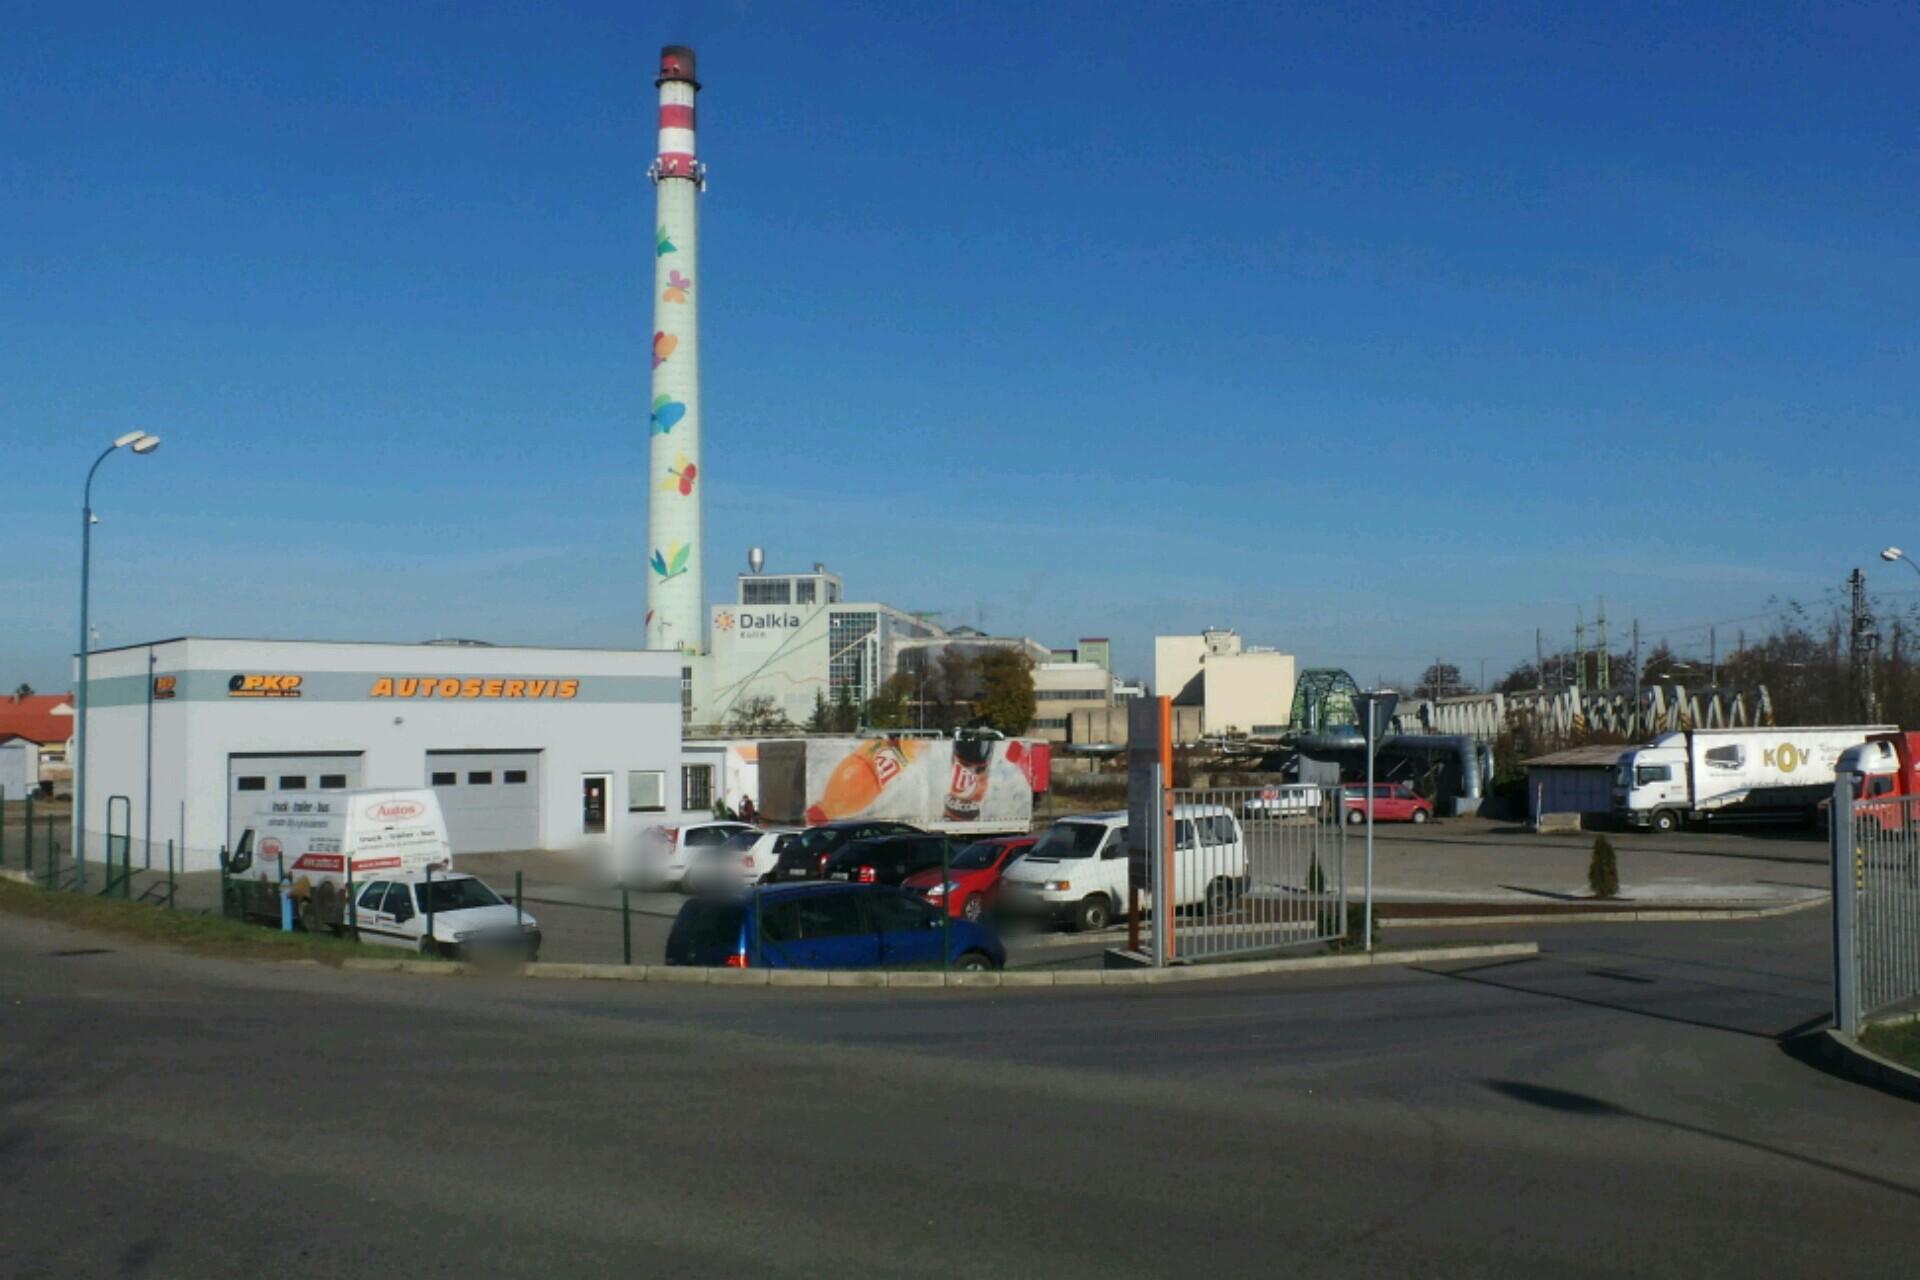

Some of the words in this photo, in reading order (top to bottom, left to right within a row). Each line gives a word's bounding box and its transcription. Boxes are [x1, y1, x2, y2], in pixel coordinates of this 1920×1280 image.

[740, 612, 800, 629] Dalkia
[369, 677, 580, 698] AUTOSERVIS
[1763, 743, 1810, 773] KOV
[377, 805, 416, 817] Autos
